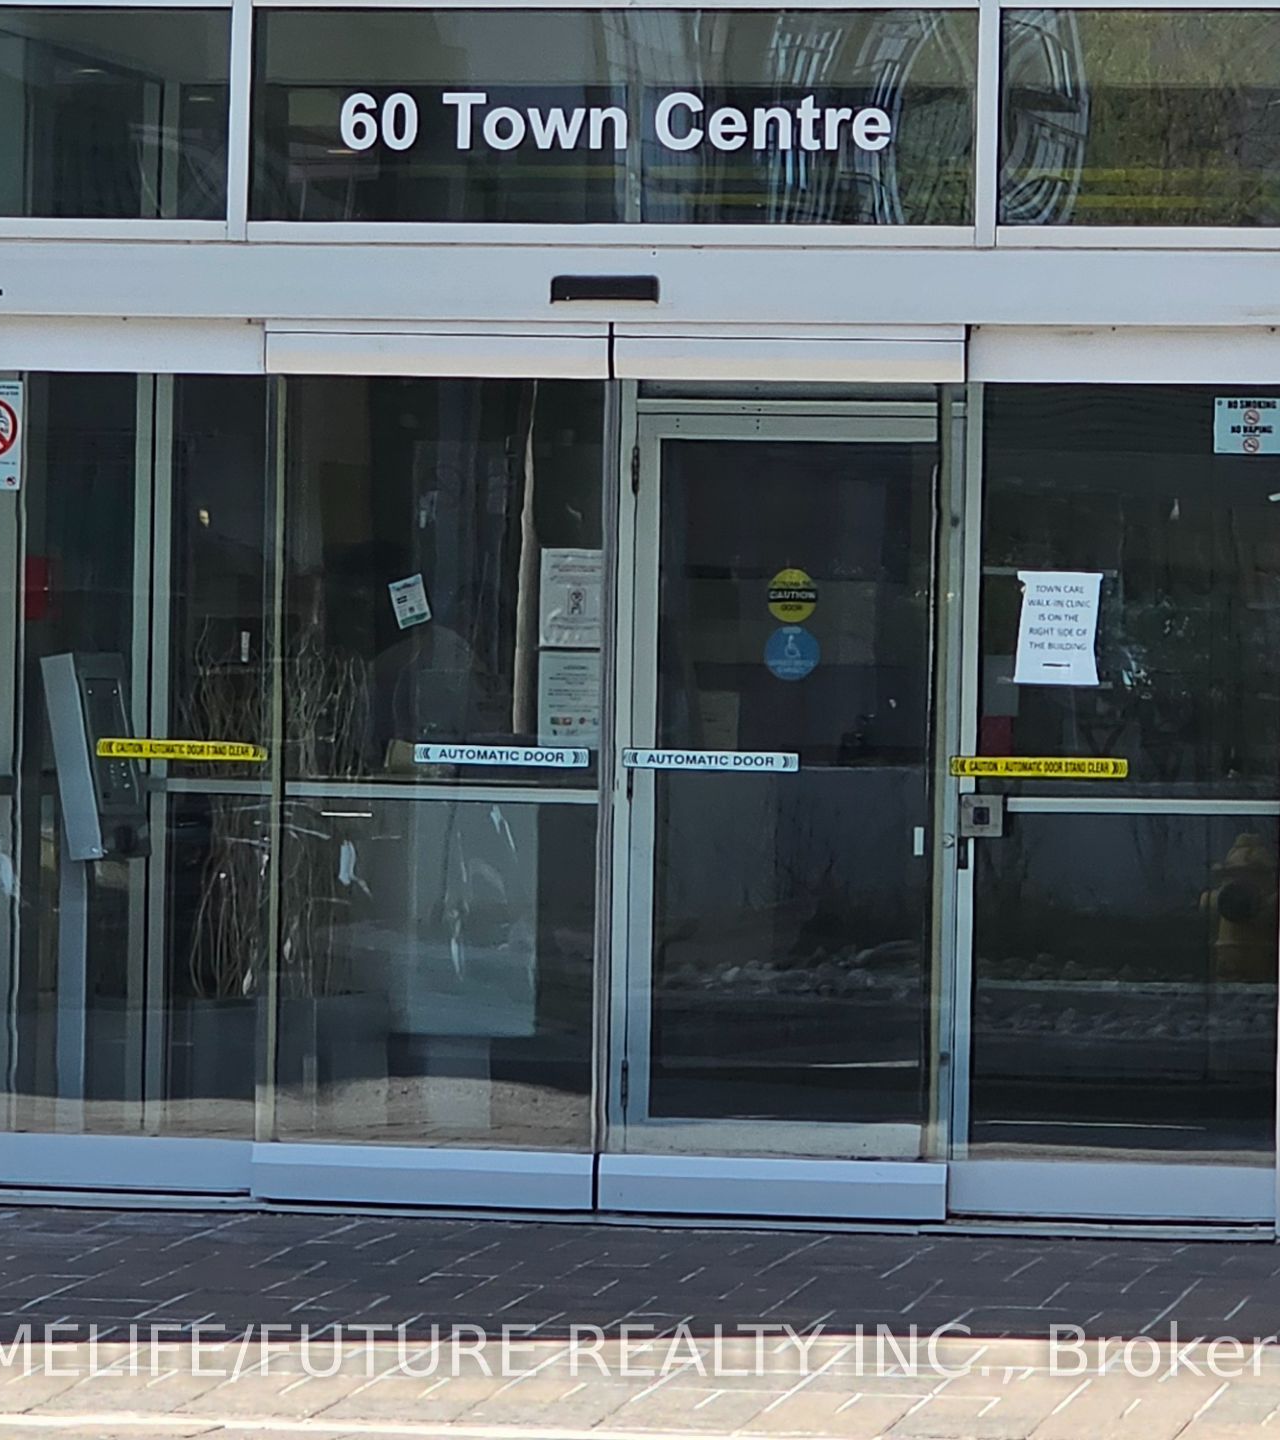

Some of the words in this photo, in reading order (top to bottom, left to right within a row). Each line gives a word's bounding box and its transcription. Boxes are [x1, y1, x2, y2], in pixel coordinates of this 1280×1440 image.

[339, 92, 419, 151] 60
[442, 92, 629, 151] Town
[655, 92, 892, 152] Centre
[1036, 585, 1061, 593] TOWN
[1063, 585, 1085, 594] CARE
[769, 591, 816, 599] CAUTION
[1065, 600, 1091, 608] CLINIC
[1038, 613, 1046, 621] IS
[1064, 614, 1079, 622] THE
[1029, 627, 1054, 636] RIGHT
[1076, 628, 1087, 636] OF
[1029, 641, 1045, 650] THE
[1047, 642, 1087, 650] BUILDING
[439, 748, 519, 761] AUTOMATIC
[523, 751, 565, 763] DOOR
[647, 753, 728, 766] AUTOMATIC
[733, 755, 774, 767] DOOR
[970, 760, 997, 771] CAUTION
[1005, 761, 1042, 772] AUTOMATIC
[1044, 761, 1062, 773] DOOR
[1065, 761, 1086, 773] STAND
[1087, 762, 1109, 773] CLEAR
